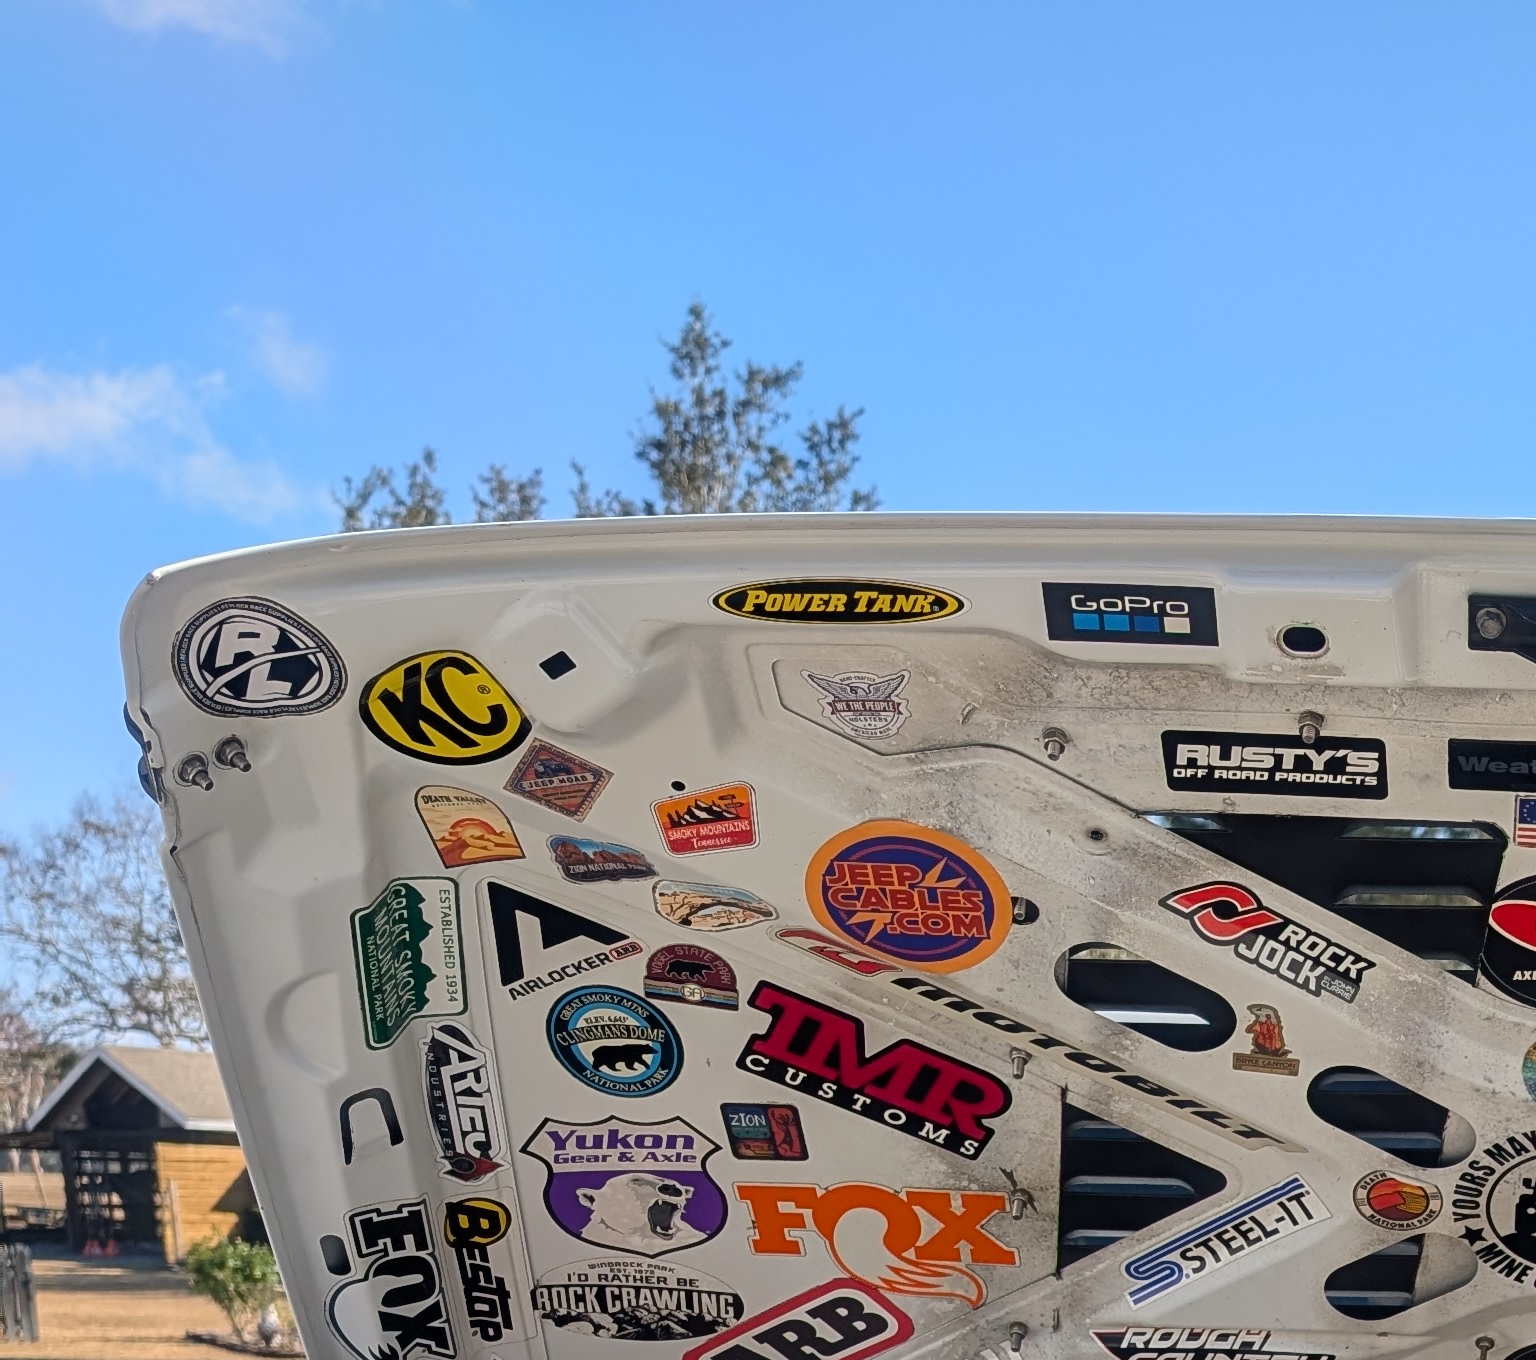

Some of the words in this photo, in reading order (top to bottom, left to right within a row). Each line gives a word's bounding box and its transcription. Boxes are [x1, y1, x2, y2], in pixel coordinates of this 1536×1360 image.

[745, 590, 844, 614] POWER
[850, 590, 934, 613] TANK
[1070, 594, 1189, 615] GoPro
[377, 656, 508, 749] KC
[866, 701, 894, 711] PEOPLE
[1177, 744, 1379, 773] RUSTY'S
[527, 779, 554, 789] JEEP
[557, 774, 588, 785] MOAB
[1173, 768, 1208, 780] OFF
[1214, 769, 1268, 782] ROAD
[1275, 772, 1378, 786] PRODUCTS
[668, 826, 697, 842] SMOKY
[700, 821, 751, 836] MOUNTAINS
[569, 863, 587, 874] ZION
[588, 863, 628, 873] NATIONAL
[825, 861, 923, 888] JEEP
[387, 885, 410, 942] GREAT
[828, 886, 986, 914] CABLES
[438, 888, 456, 970] ESTABLISHED
[614, 943, 641, 959] ARB
[674, 946, 711, 959] STATE
[1236, 934, 1327, 992] JOCK
[1278, 923, 1369, 980] ROCK
[366, 935, 381, 992] NATIONAL
[375, 994, 385, 1021] PARK
[373, 908, 401, 1027] MOUNTAINS
[508, 952, 614, 1001] AIRLOCKER
[391, 949, 418, 1015] SMOKY
[444, 973, 458, 1003] 1934
[1320, 979, 1353, 1001] CURRIE
[1330, 978, 1356, 994] JOHN
[560, 996, 582, 1021] GREAT
[580, 990, 621, 1008] SMOKY
[620, 995, 650, 1019] MTNS
[556, 1026, 628, 1047] CLINGMANS
[631, 1024, 666, 1043] DOME
[752, 985, 1006, 1141] TMR
[1262, 1058, 1297, 1070] CANYON
[583, 1069, 645, 1092] NATIONAL
[644, 1066, 669, 1090] PARK
[422, 1039, 454, 1157] INDUSTRIES
[430, 1025, 493, 1162] ARTEC
[745, 1053, 980, 1157] CUSTOMS
[728, 1113, 767, 1129] ZION
[545, 1129, 695, 1152] Yukon
[553, 1152, 613, 1165] Gear
[617, 1151, 637, 1164] &
[641, 1151, 697, 1164] Axle
[1359, 1171, 1388, 1191] DEATH
[1452, 1159, 1497, 1223] YOURS
[1368, 1213, 1417, 1229] NATIONAL
[1418, 1208, 1438, 1225] PARK
[1179, 1190, 1318, 1276] STEEL-IT
[736, 1184, 1020, 1311] FOX
[360, 1201, 452, 1355] FOX
[1475, 1243, 1534, 1285] MINE
[566, 1272, 589, 1283] I'D
[598, 1273, 669, 1286] RATHER
[676, 1277, 700, 1288] BE
[535, 1286, 599, 1314] ROCK
[605, 1286, 735, 1319] CRAWLING
[1120, 1328, 1272, 1350] ROUGH
